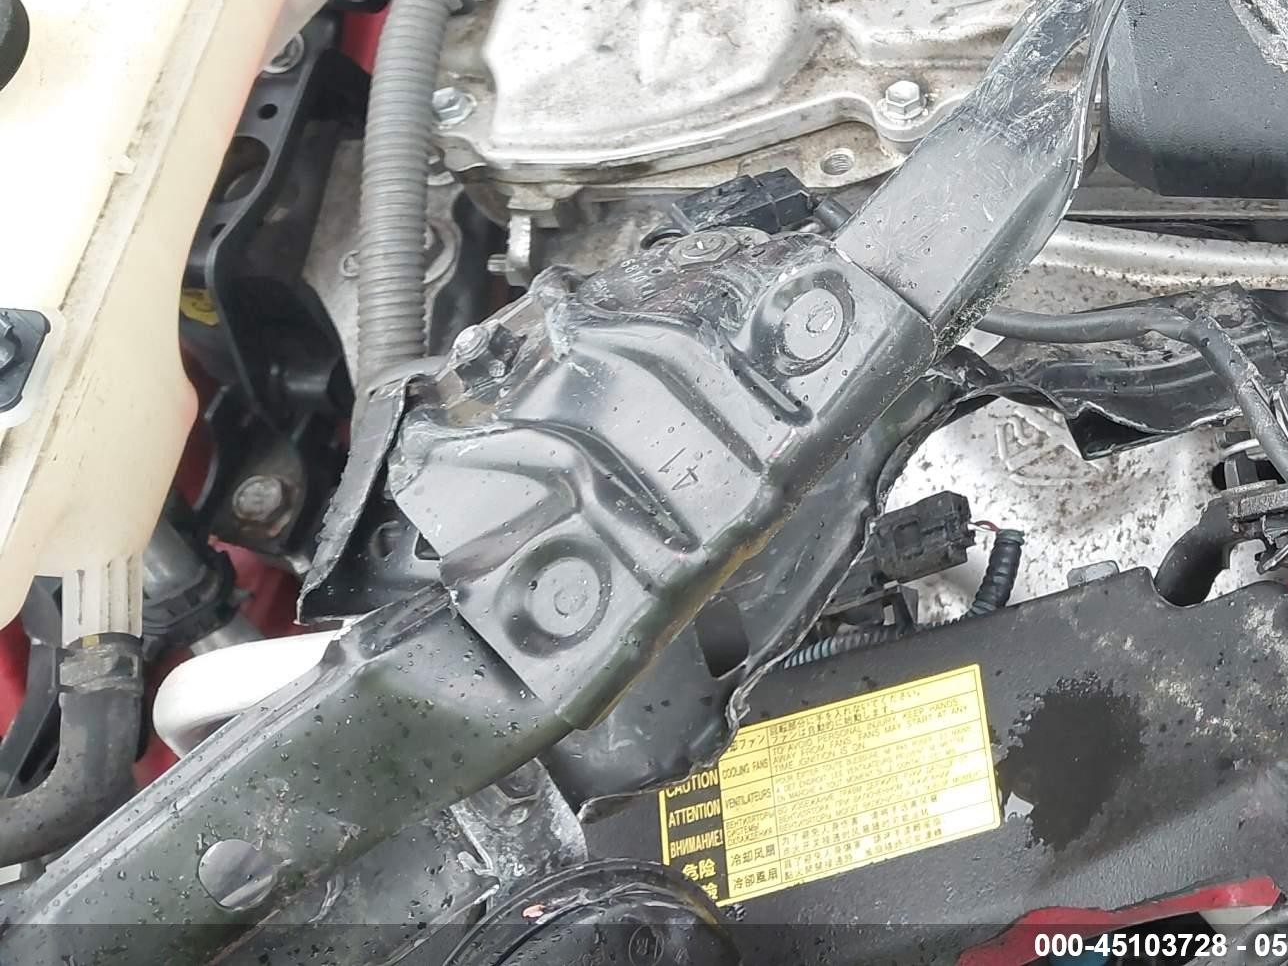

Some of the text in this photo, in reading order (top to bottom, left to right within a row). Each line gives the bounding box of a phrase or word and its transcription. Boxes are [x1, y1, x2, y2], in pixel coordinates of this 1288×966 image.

[771, 749, 797, 765] AWAY
[800, 742, 825, 757] FROM
[857, 727, 880, 741] FANS
[787, 737, 813, 752] AVOID
[816, 723, 861, 744] PERSONAL
[721, 756, 769, 780] COOLING FANS
[773, 760, 793, 773] TIME
[797, 748, 836, 766] IGNITION
[839, 744, 850, 755] IS
[666, 769, 719, 798] CAUTION
[724, 786, 771, 810] VENTILATEURS
[668, 799, 721, 828] ATTENTION
[669, 829, 723, 859] ВНИМАНИЕ!
